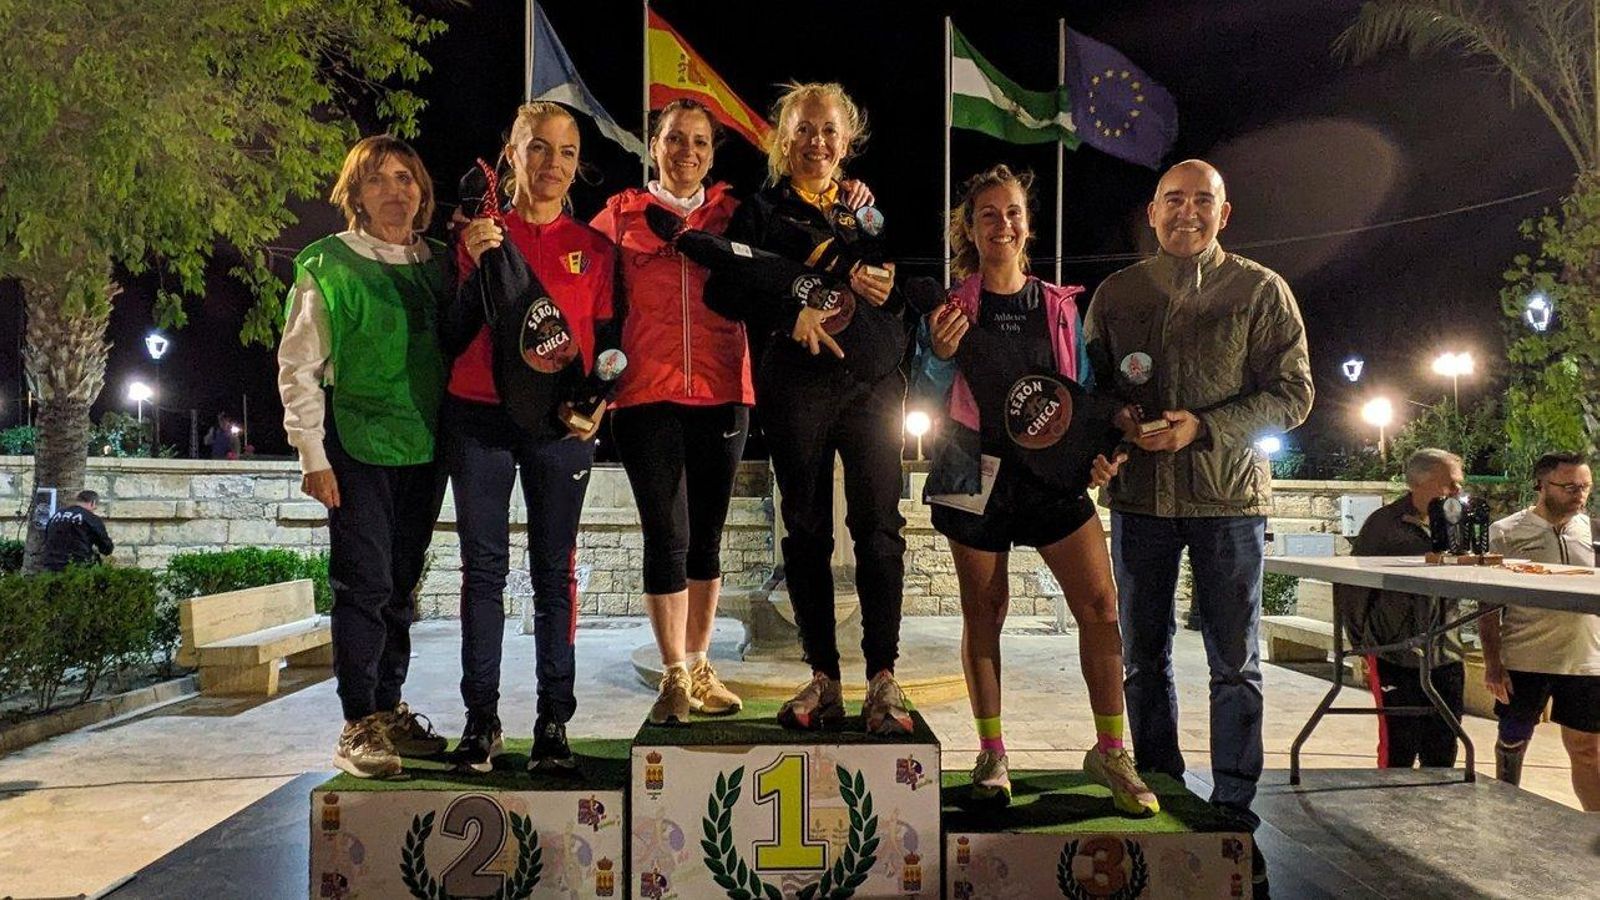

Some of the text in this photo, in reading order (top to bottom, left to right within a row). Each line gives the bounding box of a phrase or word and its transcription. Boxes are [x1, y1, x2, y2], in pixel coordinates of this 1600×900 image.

[535, 331, 570, 356] CHECA
[1027, 400, 1060, 436] CHECA
[752, 751, 829, 875] 1
[439, 792, 508, 900] 2
[1073, 836, 1126, 896] 3
